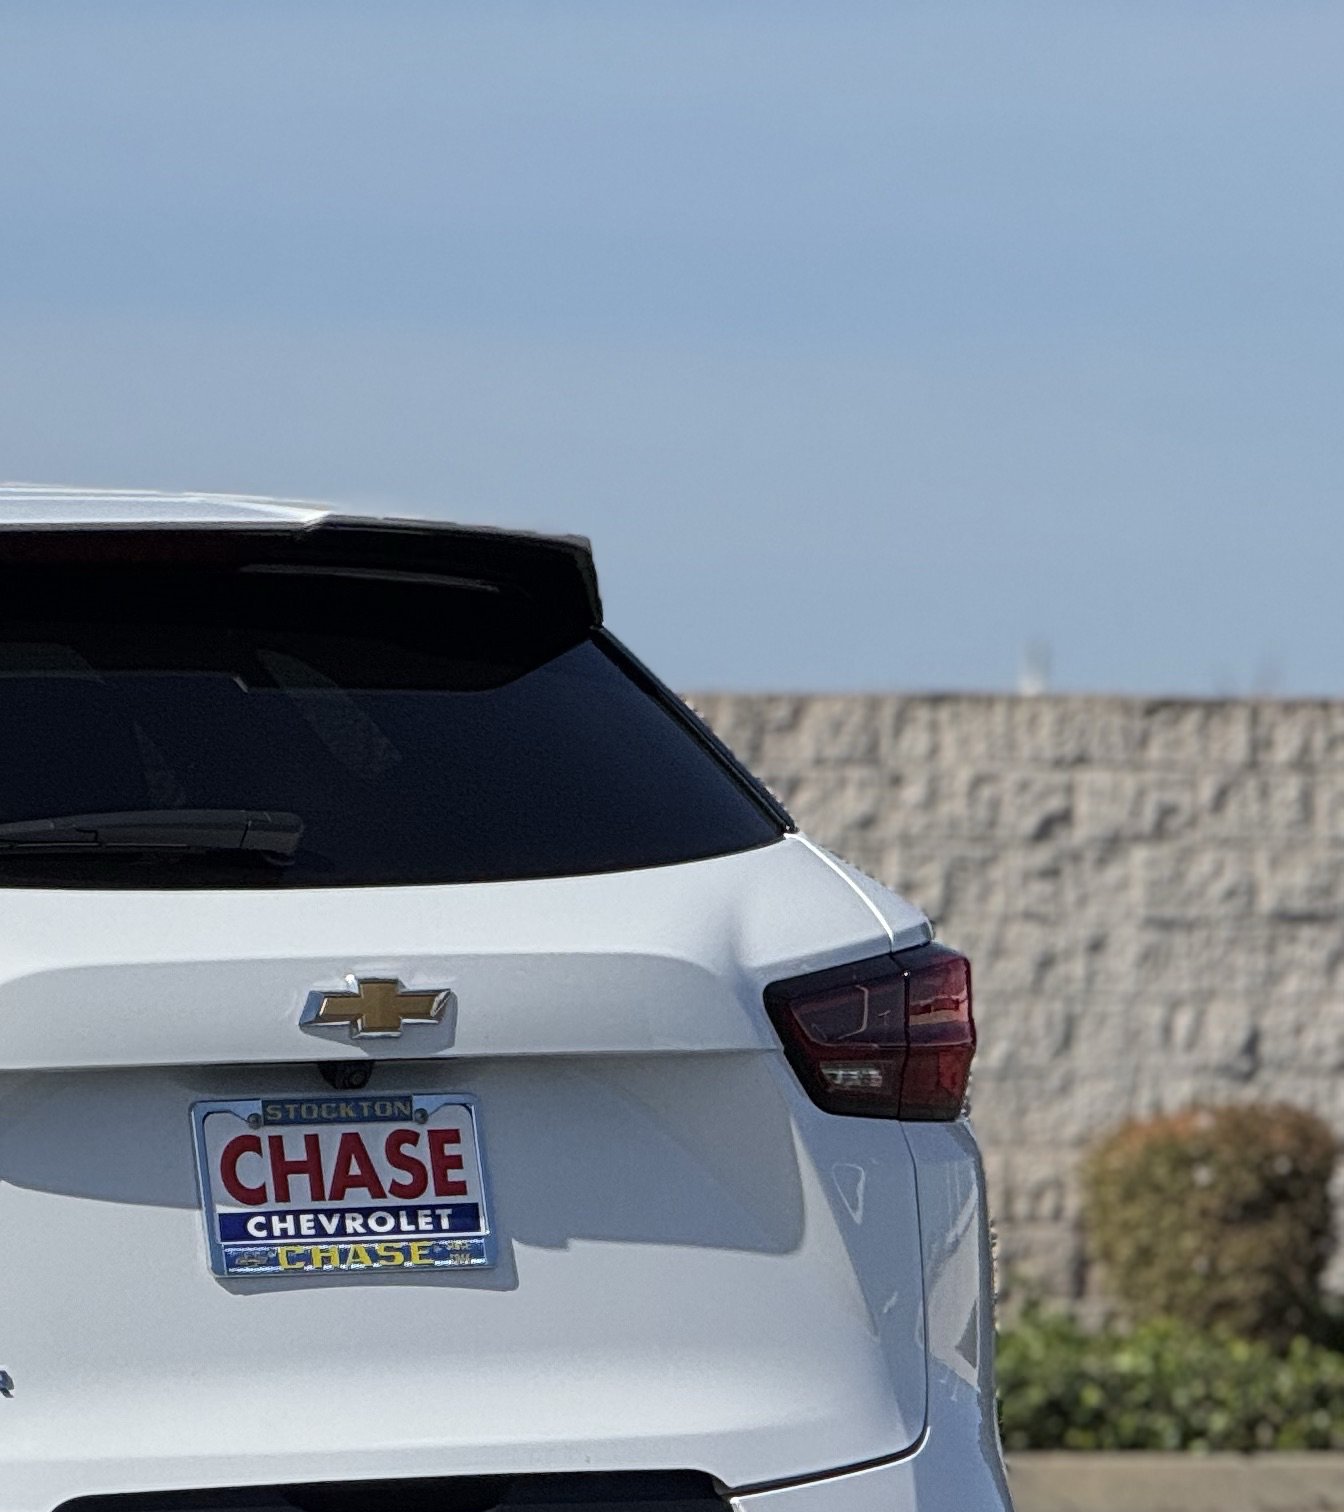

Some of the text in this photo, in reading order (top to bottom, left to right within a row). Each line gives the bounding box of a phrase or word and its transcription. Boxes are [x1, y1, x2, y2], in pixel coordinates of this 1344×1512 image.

[265, 1102, 411, 1120] STOCKTON
[220, 1128, 468, 1206] CHASE
[246, 1208, 453, 1237] CHEVROLET
[278, 1241, 435, 1270] CHASE
